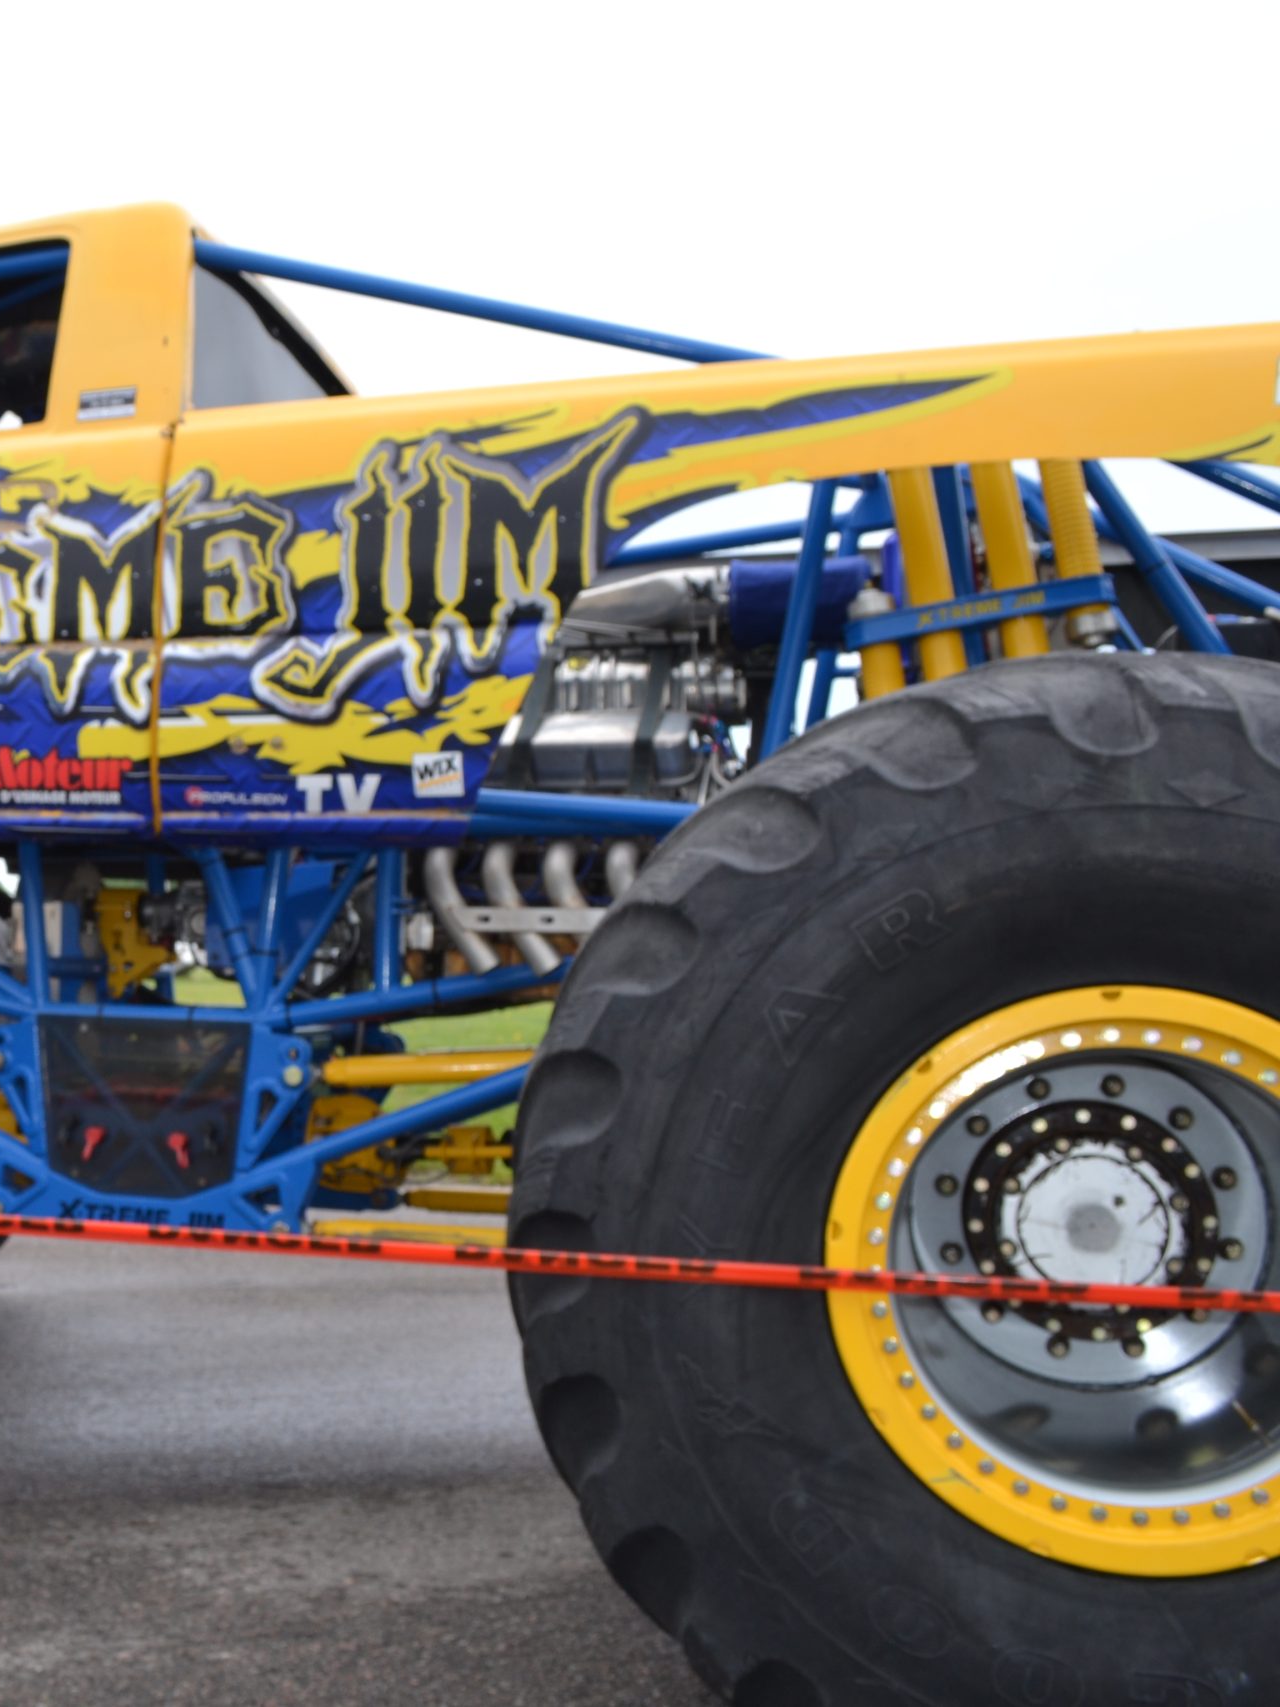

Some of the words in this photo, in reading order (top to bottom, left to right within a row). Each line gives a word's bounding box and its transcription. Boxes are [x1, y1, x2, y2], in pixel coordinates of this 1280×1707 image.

[250, 404, 650, 722] JIM
[415, 756, 458, 781] WIX
[296, 774, 382, 815] TV
